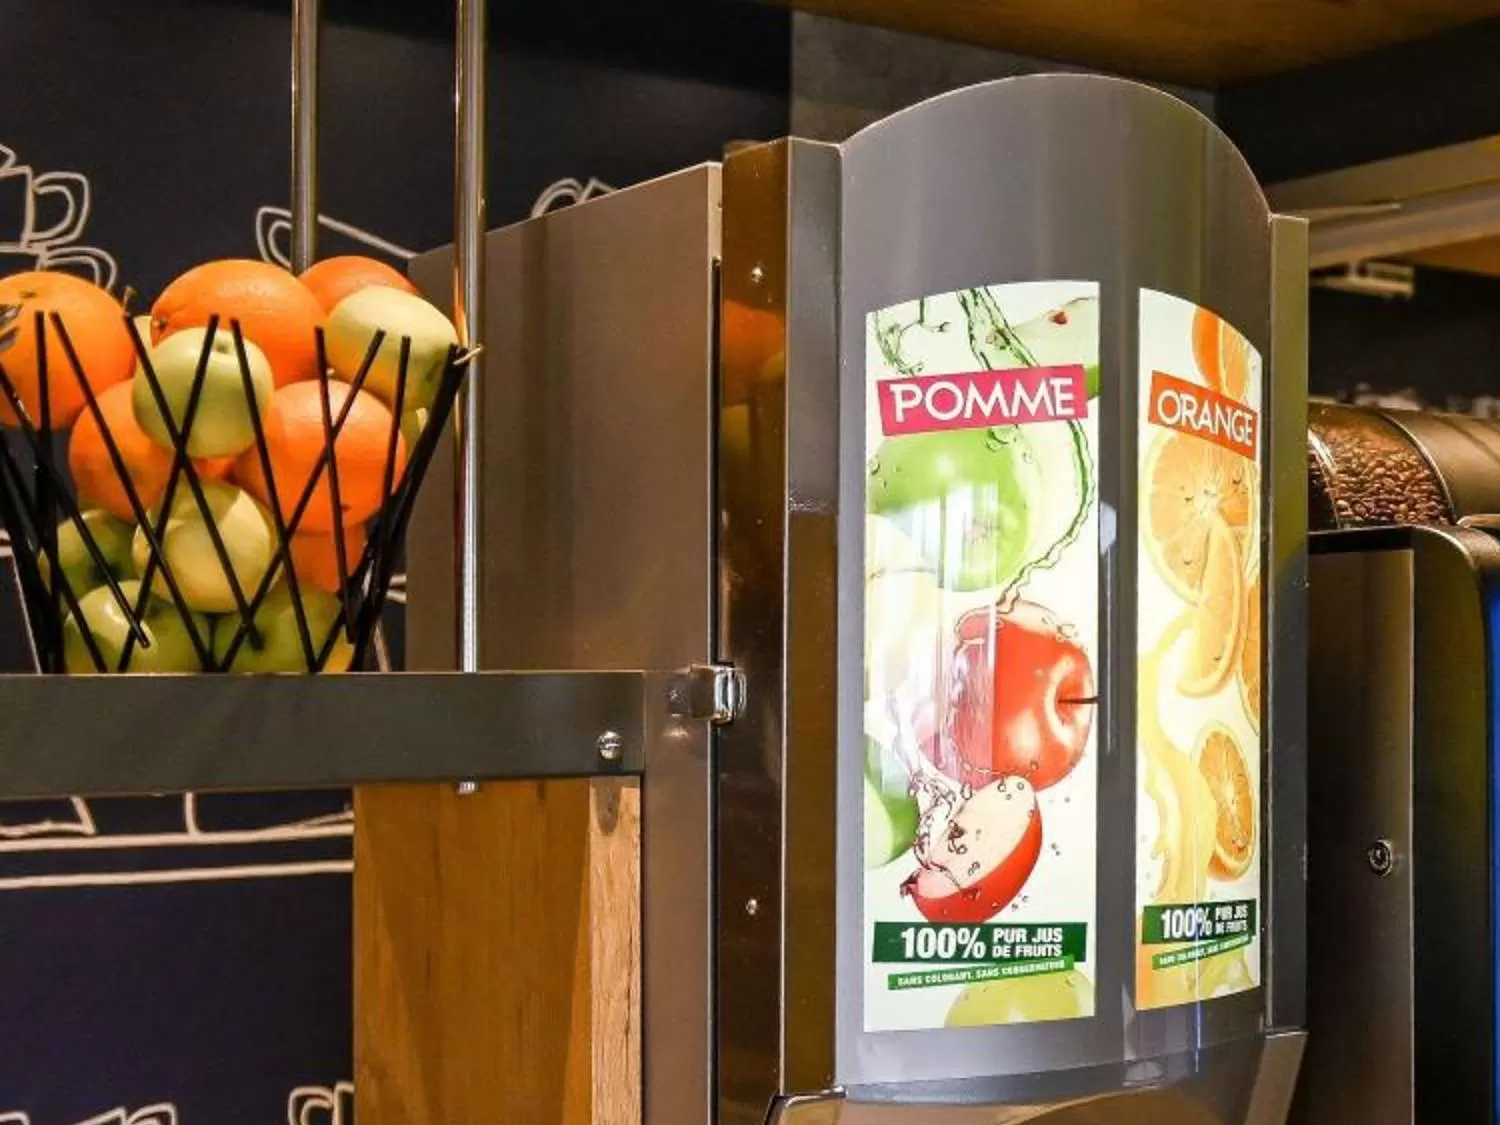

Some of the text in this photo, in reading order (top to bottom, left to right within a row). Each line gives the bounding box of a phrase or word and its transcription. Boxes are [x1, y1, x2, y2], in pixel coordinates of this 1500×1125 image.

[889, 378, 1075, 422] POMME
[1157, 389, 1253, 447] ORANGE
[992, 927, 1063, 943] PUR JUS
[1161, 906, 1213, 939] 100%
[900, 927, 986, 959] 100%
[991, 943, 1062, 958] DE FRUITS
